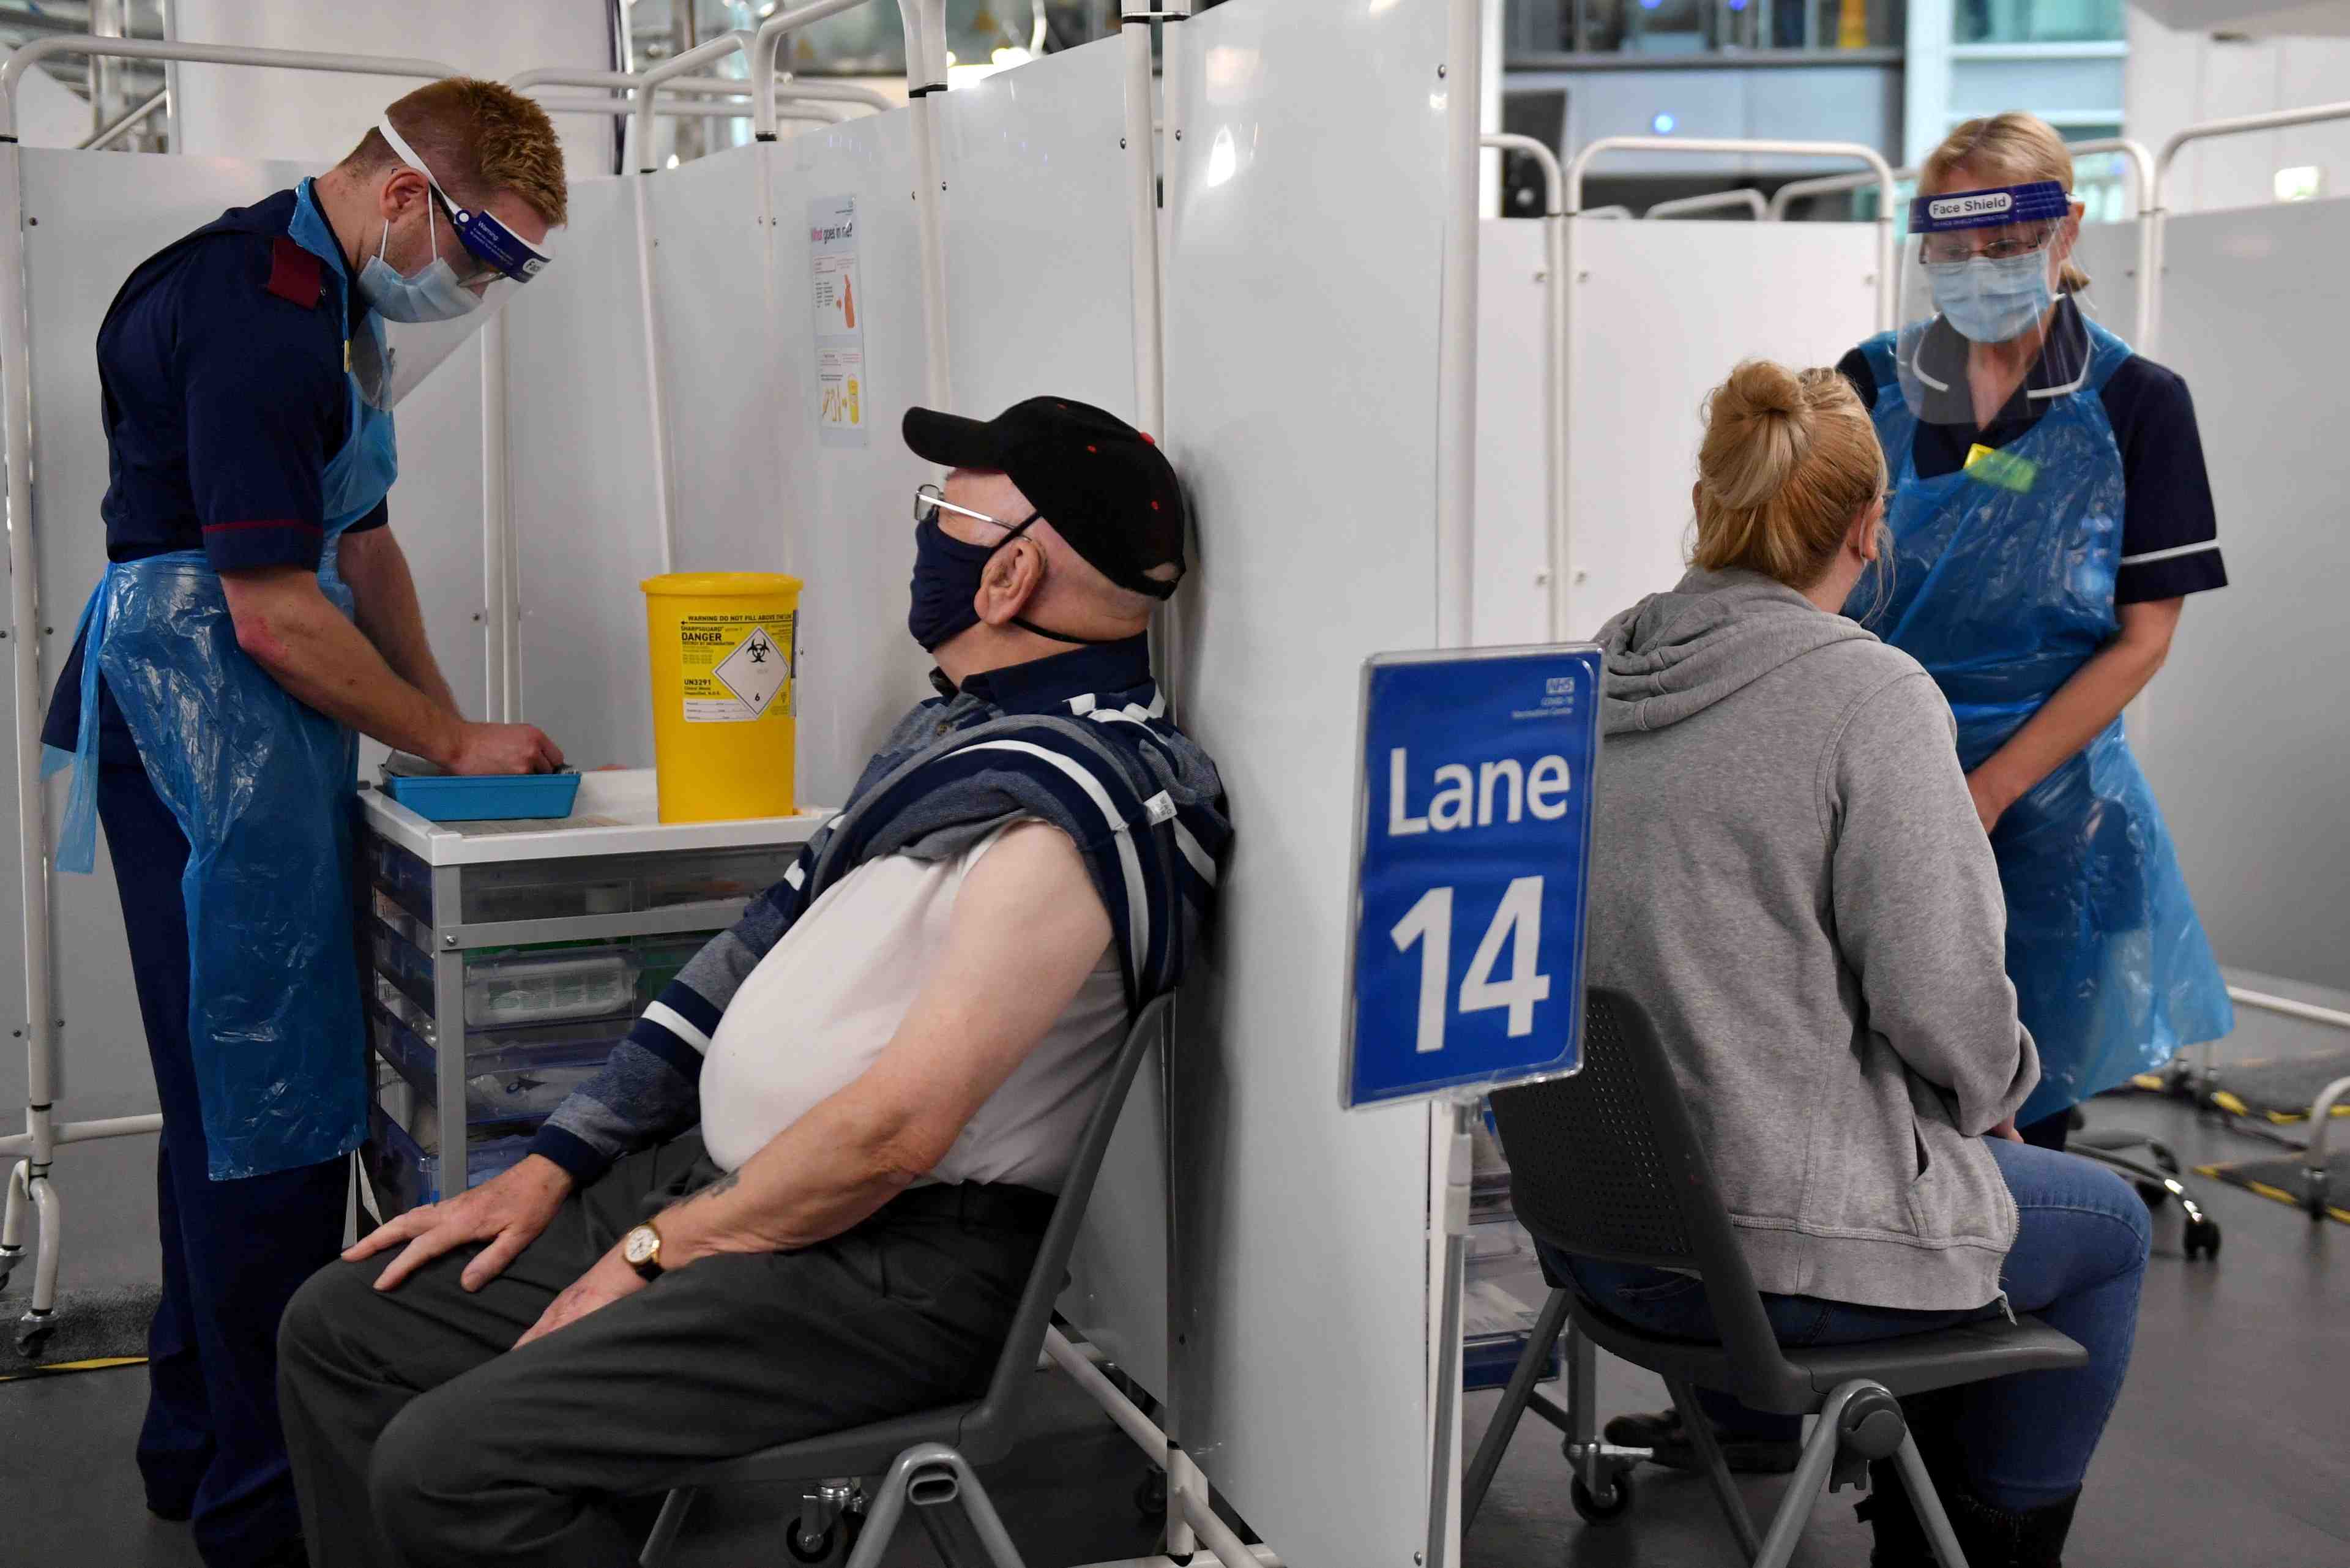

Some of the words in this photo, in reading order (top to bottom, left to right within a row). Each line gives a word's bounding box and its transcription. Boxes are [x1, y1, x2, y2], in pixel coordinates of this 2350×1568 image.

[1933, 204, 1960, 215] Face
[1964, 196, 2006, 211] Shield
[681, 632, 722, 642] DANGER
[1547, 678, 1573, 693] NHS
[755, 693, 760, 701] 6
[1389, 747, 1572, 837] Lane
[1389, 875, 1551, 1054] 14
